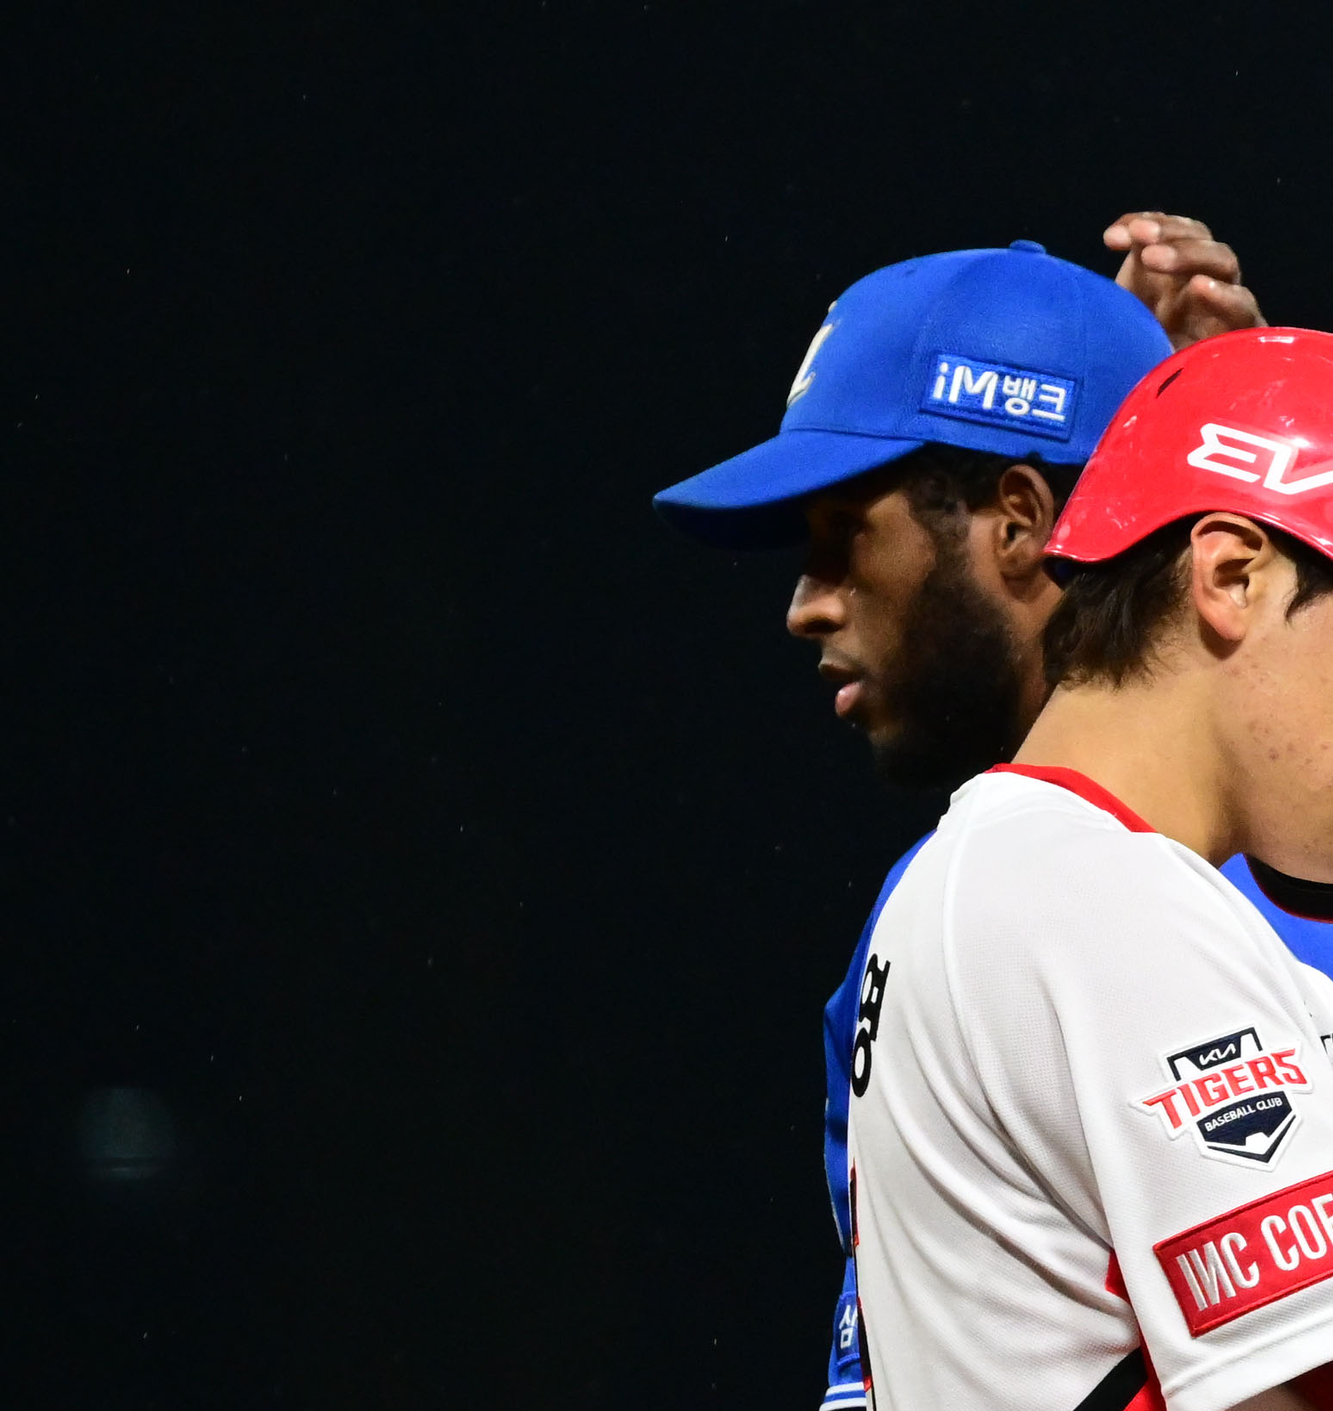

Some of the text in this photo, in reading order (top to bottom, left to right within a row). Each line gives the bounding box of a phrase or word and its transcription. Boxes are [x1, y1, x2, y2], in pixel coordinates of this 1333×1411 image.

[932, 361, 1067, 422] iM뱅크
[1142, 1048, 1308, 1130] TIGERS
[1204, 1097, 1284, 1132] BASEBALL CLUB
